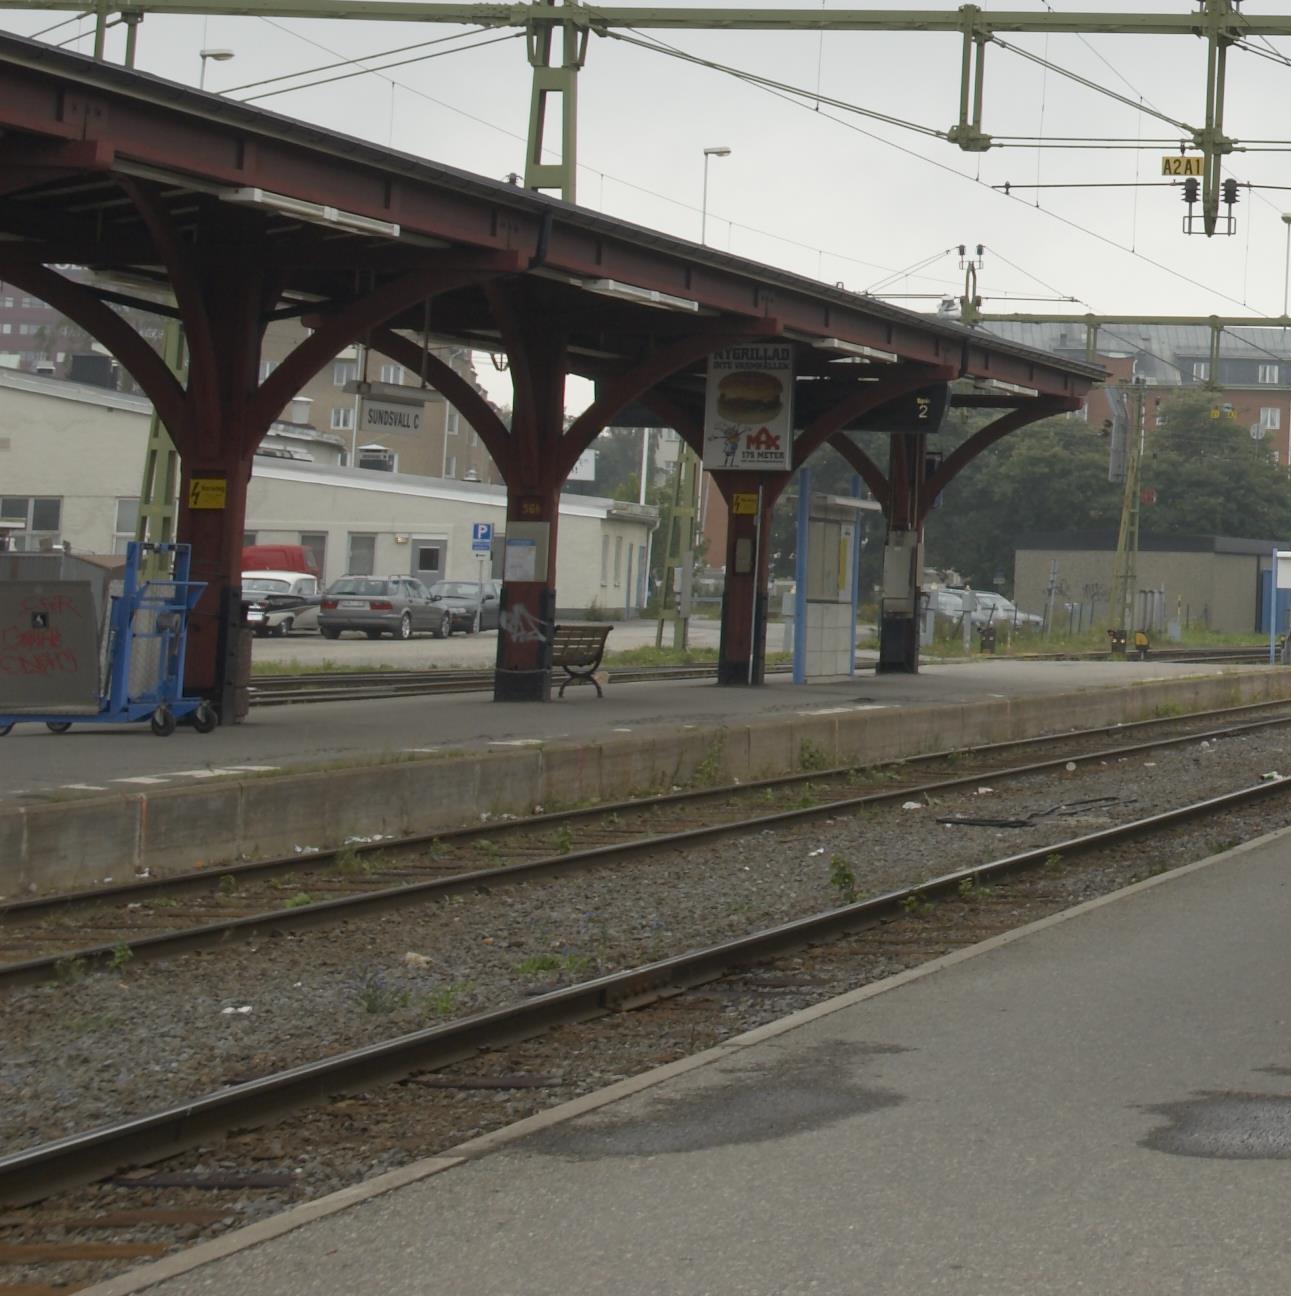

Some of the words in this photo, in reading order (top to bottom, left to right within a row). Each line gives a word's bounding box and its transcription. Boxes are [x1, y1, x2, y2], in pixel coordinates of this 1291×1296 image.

[713, 346, 790, 361] NYGRILLAD
[918, 404, 928, 418] 2
[367, 408, 411, 429] SUNDSVALL
[413, 413, 420, 430] C
[746, 426, 781, 450] MAX
[478, 524, 488, 539] P
